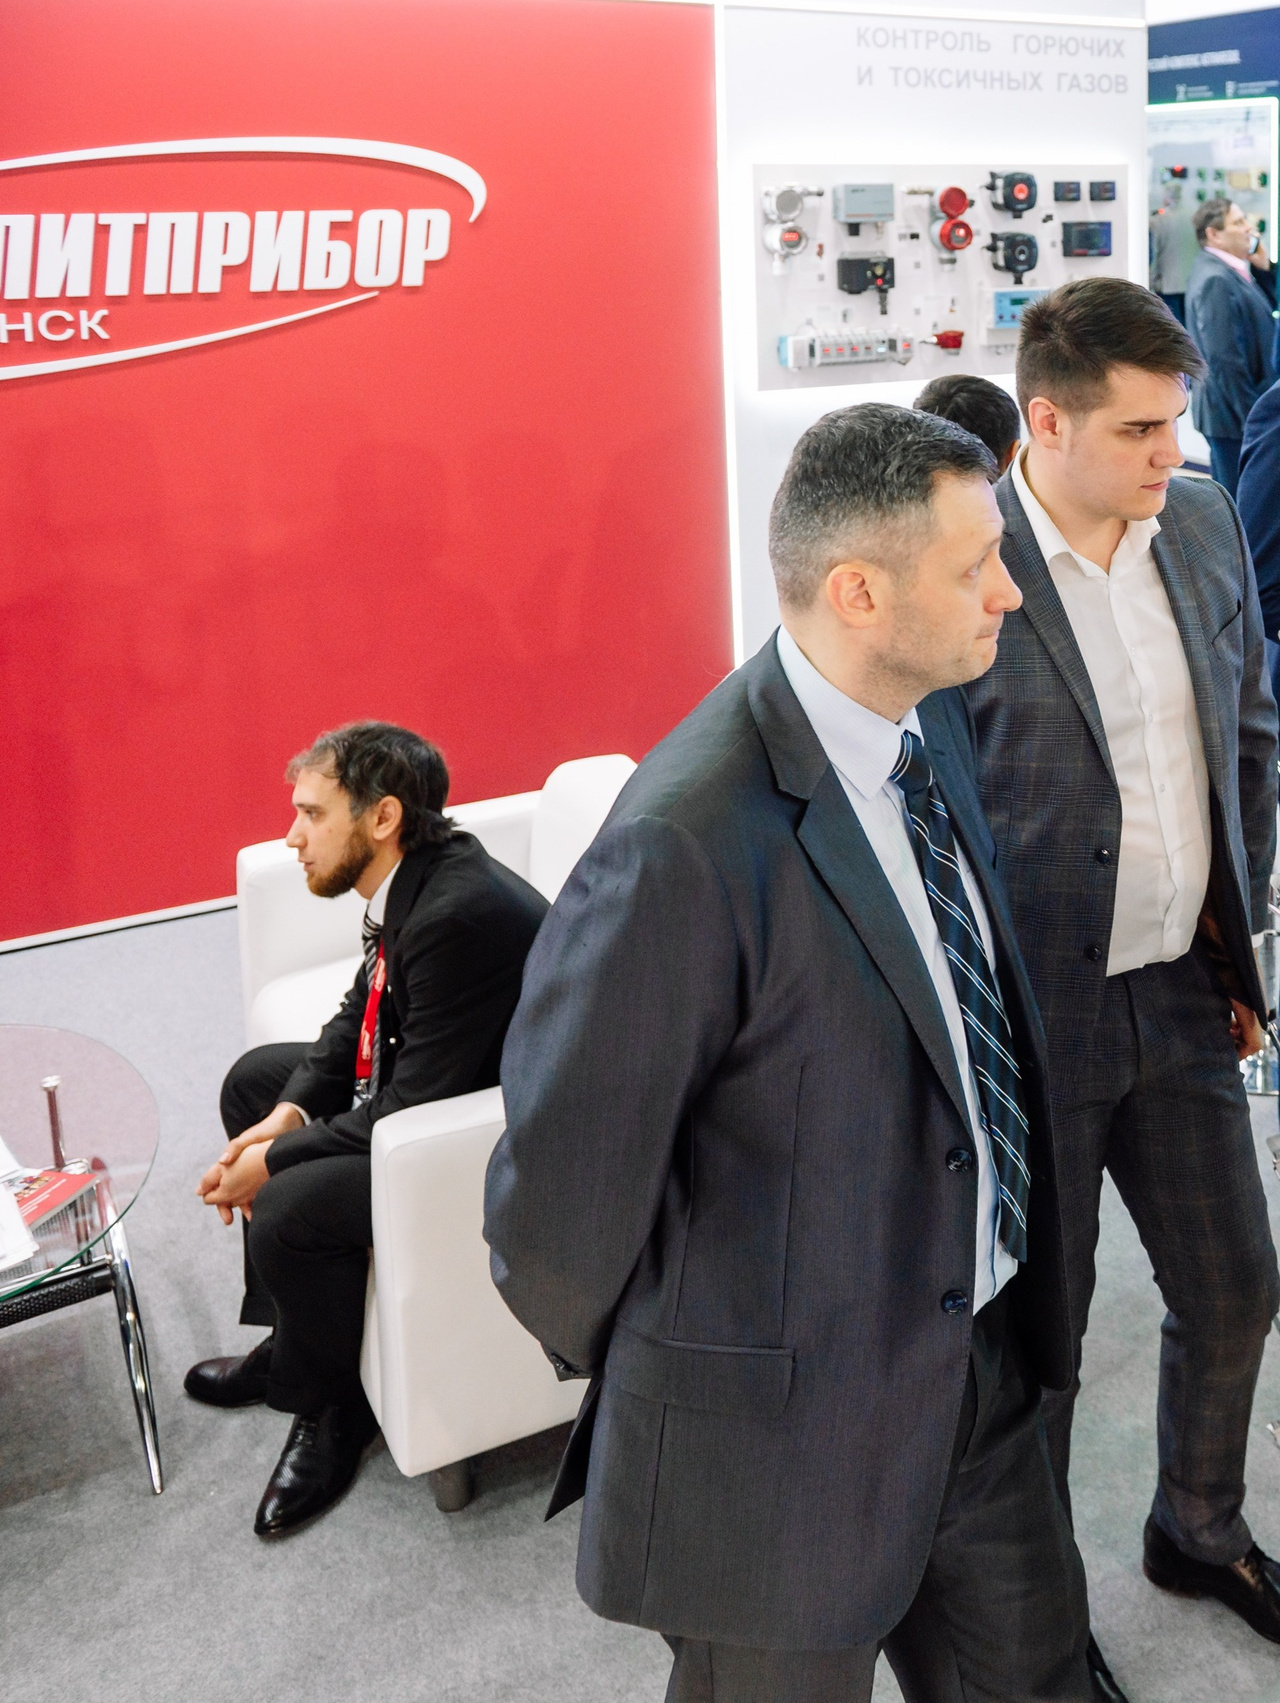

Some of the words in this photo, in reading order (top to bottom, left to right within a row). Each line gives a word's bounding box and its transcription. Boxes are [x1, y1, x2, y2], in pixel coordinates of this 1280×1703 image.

[856, 27, 992, 53] КОНТРОЛЬ
[1013, 33, 1126, 58] ГОРЮЧИХ
[857, 65, 873, 87] И
[889, 66, 1043, 92] ТОКСИЧНЫХ
[1056, 72, 1129, 94] ГАЗОВ
